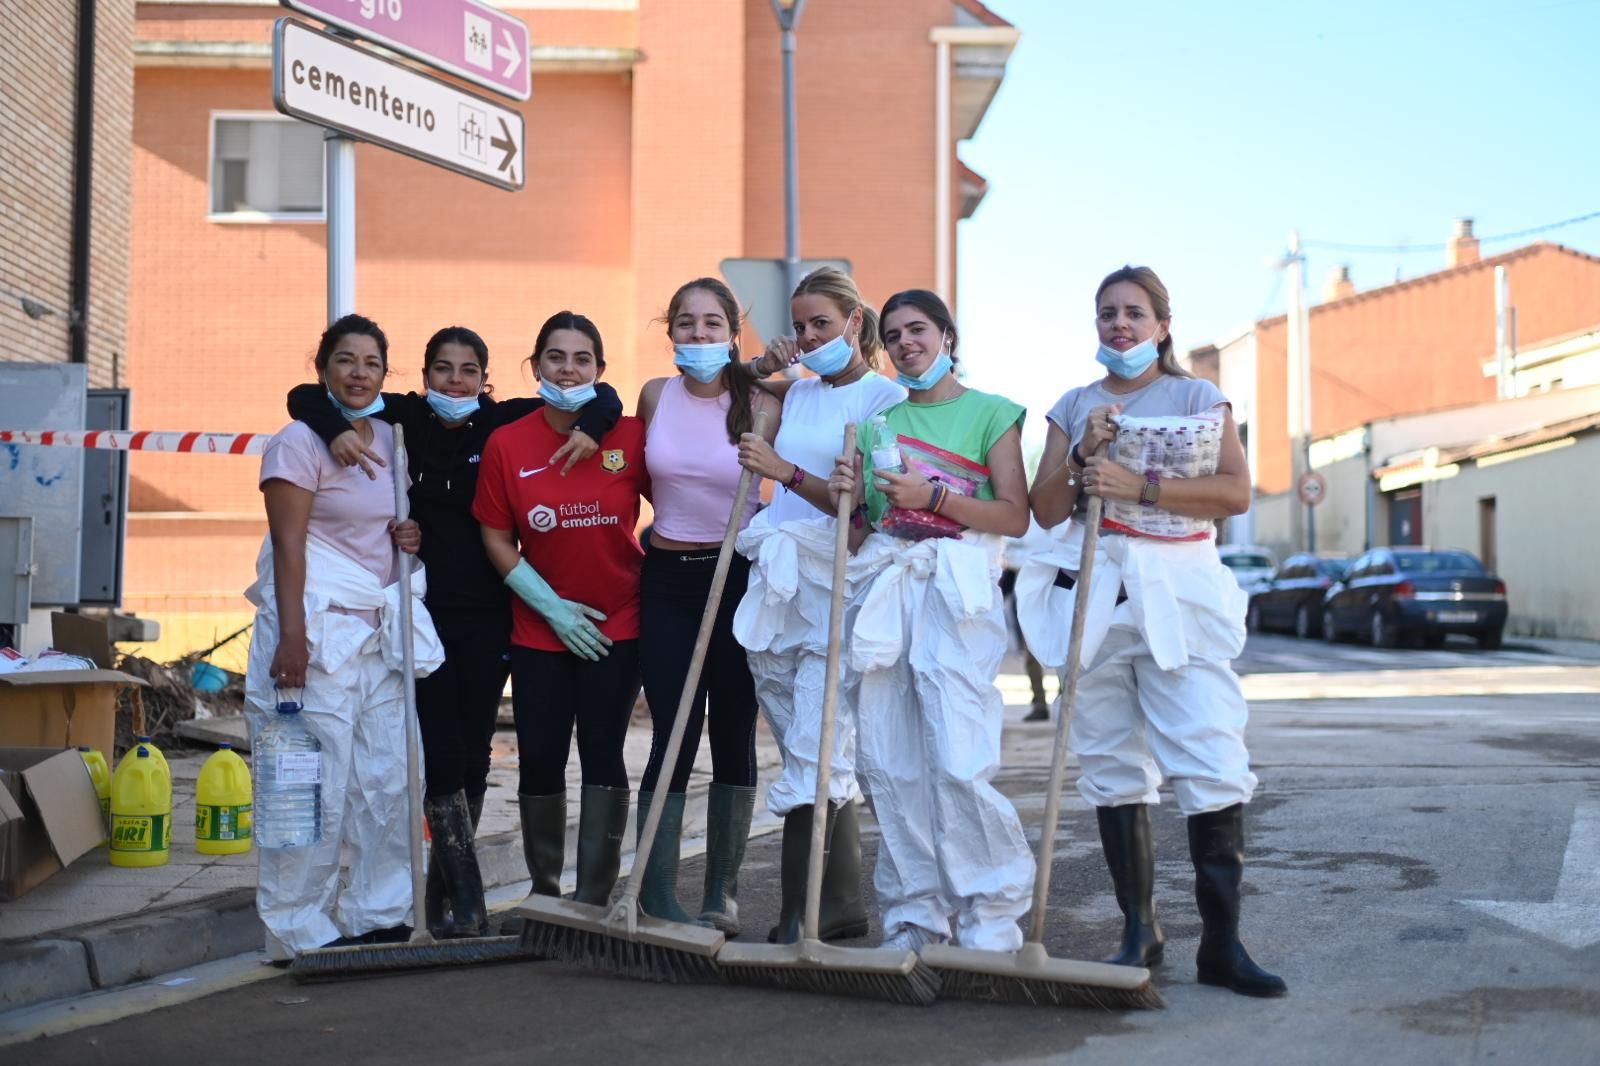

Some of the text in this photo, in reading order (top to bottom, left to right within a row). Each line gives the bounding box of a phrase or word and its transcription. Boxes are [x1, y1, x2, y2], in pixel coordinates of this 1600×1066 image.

[292, 59, 435, 132] cementerio
[560, 500, 600, 516] fútbol
[561, 514, 618, 529] emotion
